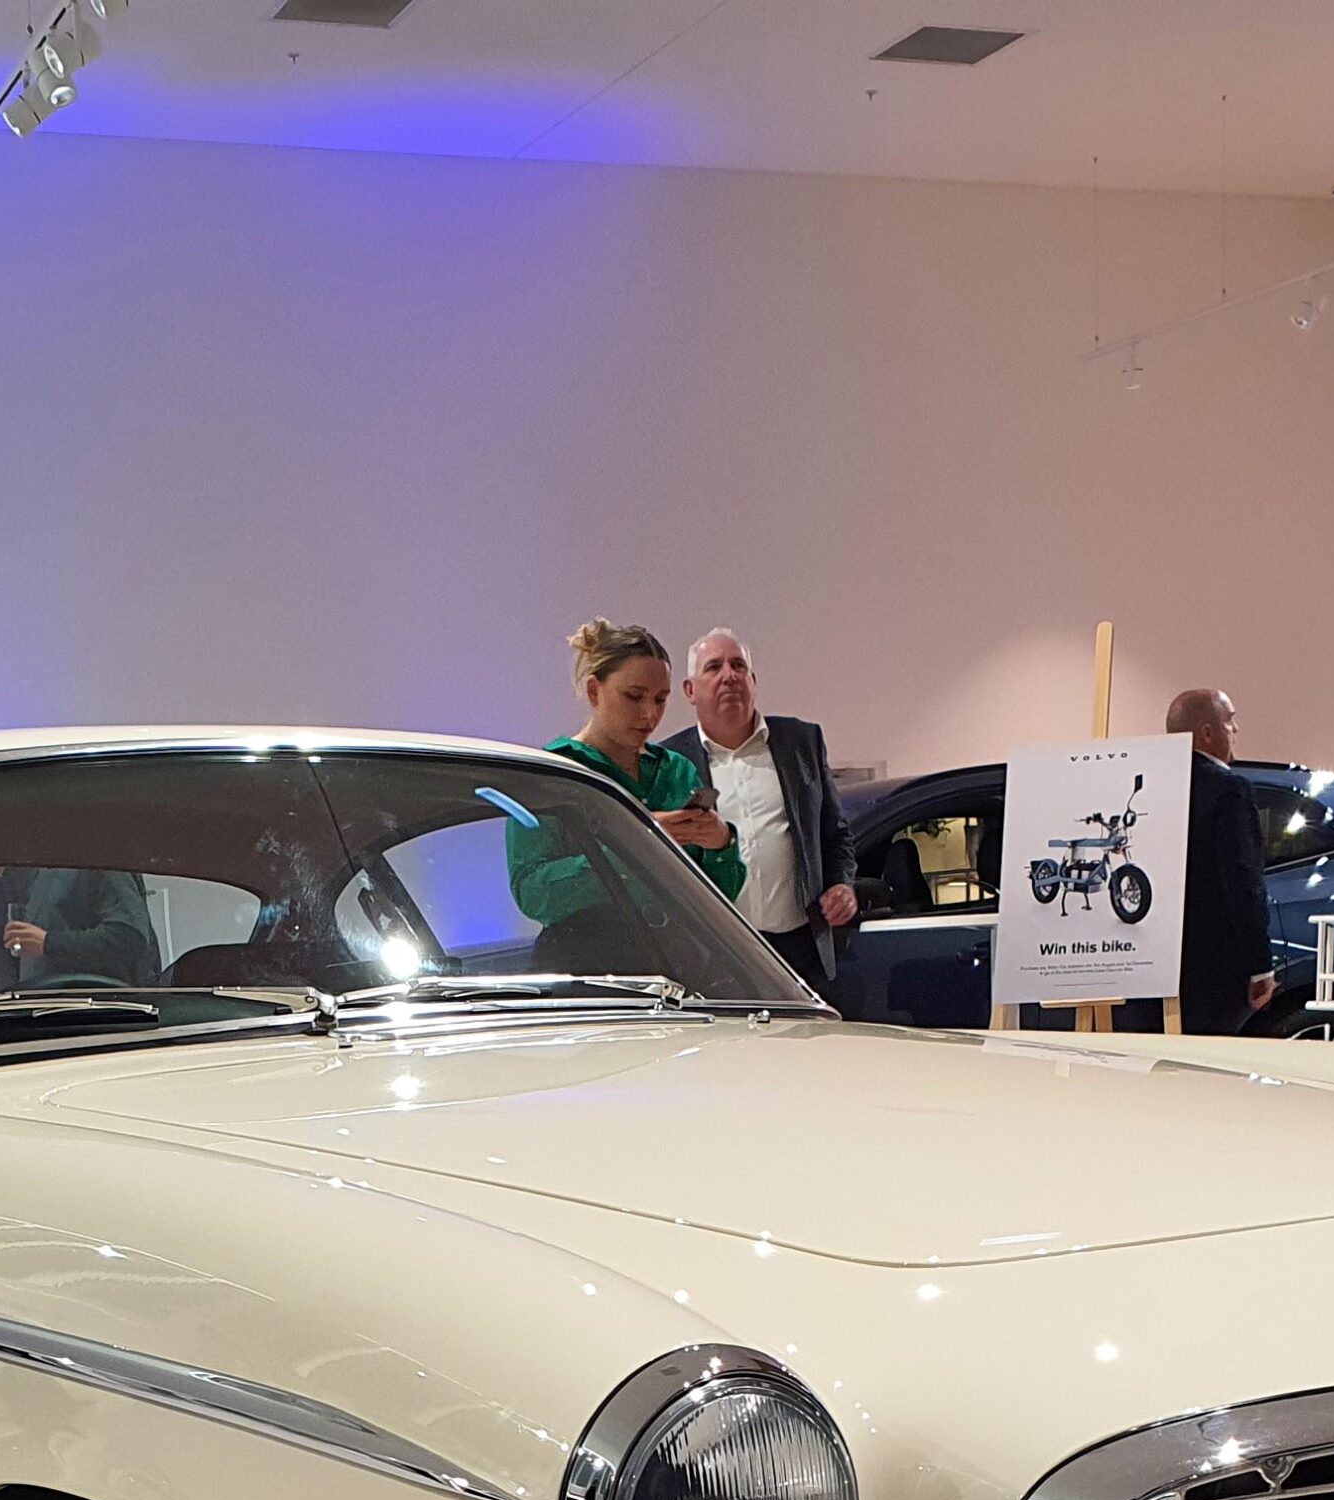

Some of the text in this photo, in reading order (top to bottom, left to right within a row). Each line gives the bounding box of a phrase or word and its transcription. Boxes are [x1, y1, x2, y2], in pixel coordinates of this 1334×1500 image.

[1070, 752, 1128, 762] VOLVO
[1039, 940, 1136, 956] Win this bike.
